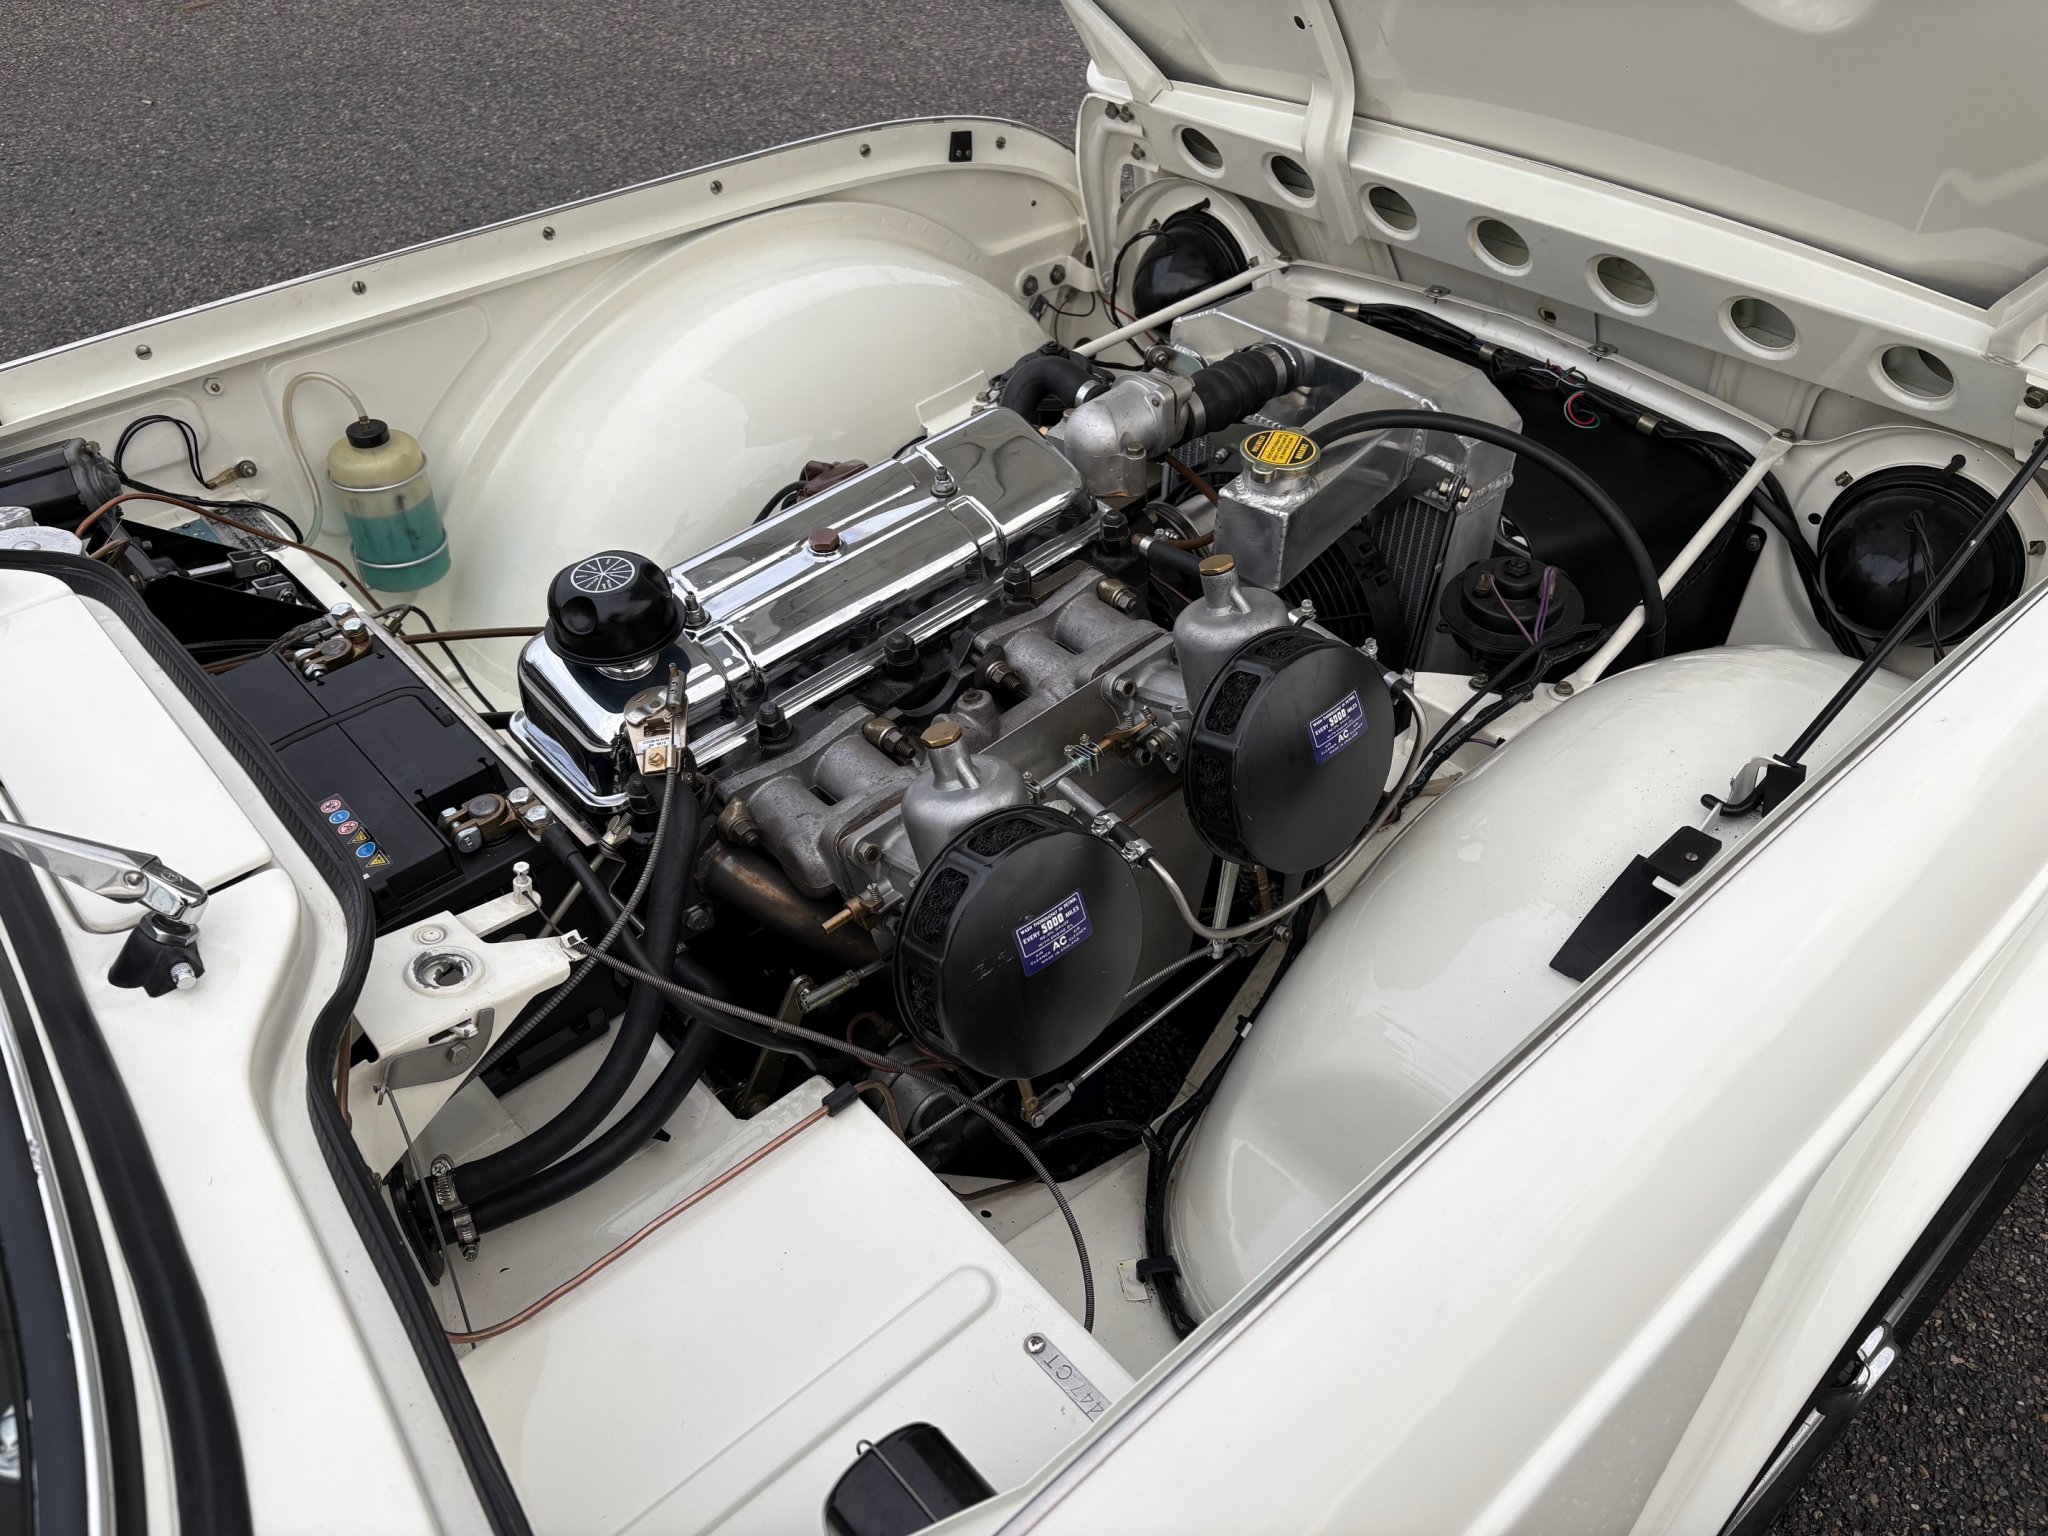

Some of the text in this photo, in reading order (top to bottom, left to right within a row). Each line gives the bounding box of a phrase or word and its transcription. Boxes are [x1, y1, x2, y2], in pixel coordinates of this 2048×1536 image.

[1315, 703, 1358, 736] EVERY 5000 MILES
[1338, 730, 1349, 743] AC
[1020, 926, 1032, 935] WASH
[1063, 897, 1077, 909] PETROL
[1023, 905, 1080, 944] EVERY 5000 MILES
[1041, 955, 1054, 964] MADE
[1061, 938, 1080, 952] ENGLAND
[1053, 936, 1068, 951] AC
